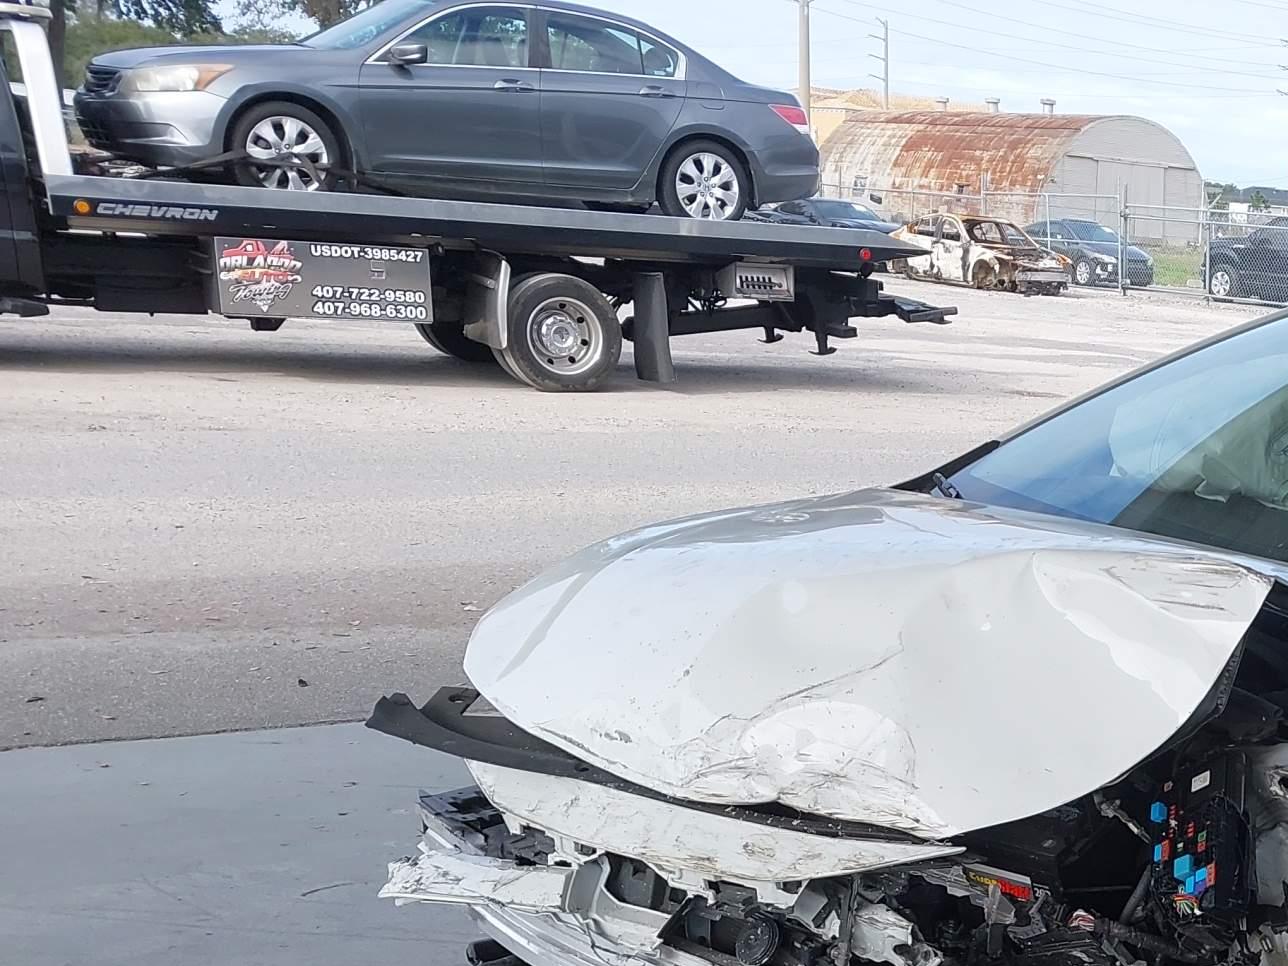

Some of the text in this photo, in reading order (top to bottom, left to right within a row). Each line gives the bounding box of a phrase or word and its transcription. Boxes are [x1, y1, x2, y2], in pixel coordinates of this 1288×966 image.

[96, 202, 219, 221] CHEVRON
[310, 244, 423, 262] USDOT-3985427
[219, 254, 302, 272] ORLANDO
[312, 286, 425, 303] 407-722-9580
[313, 301, 427, 319] 407-968-6300
